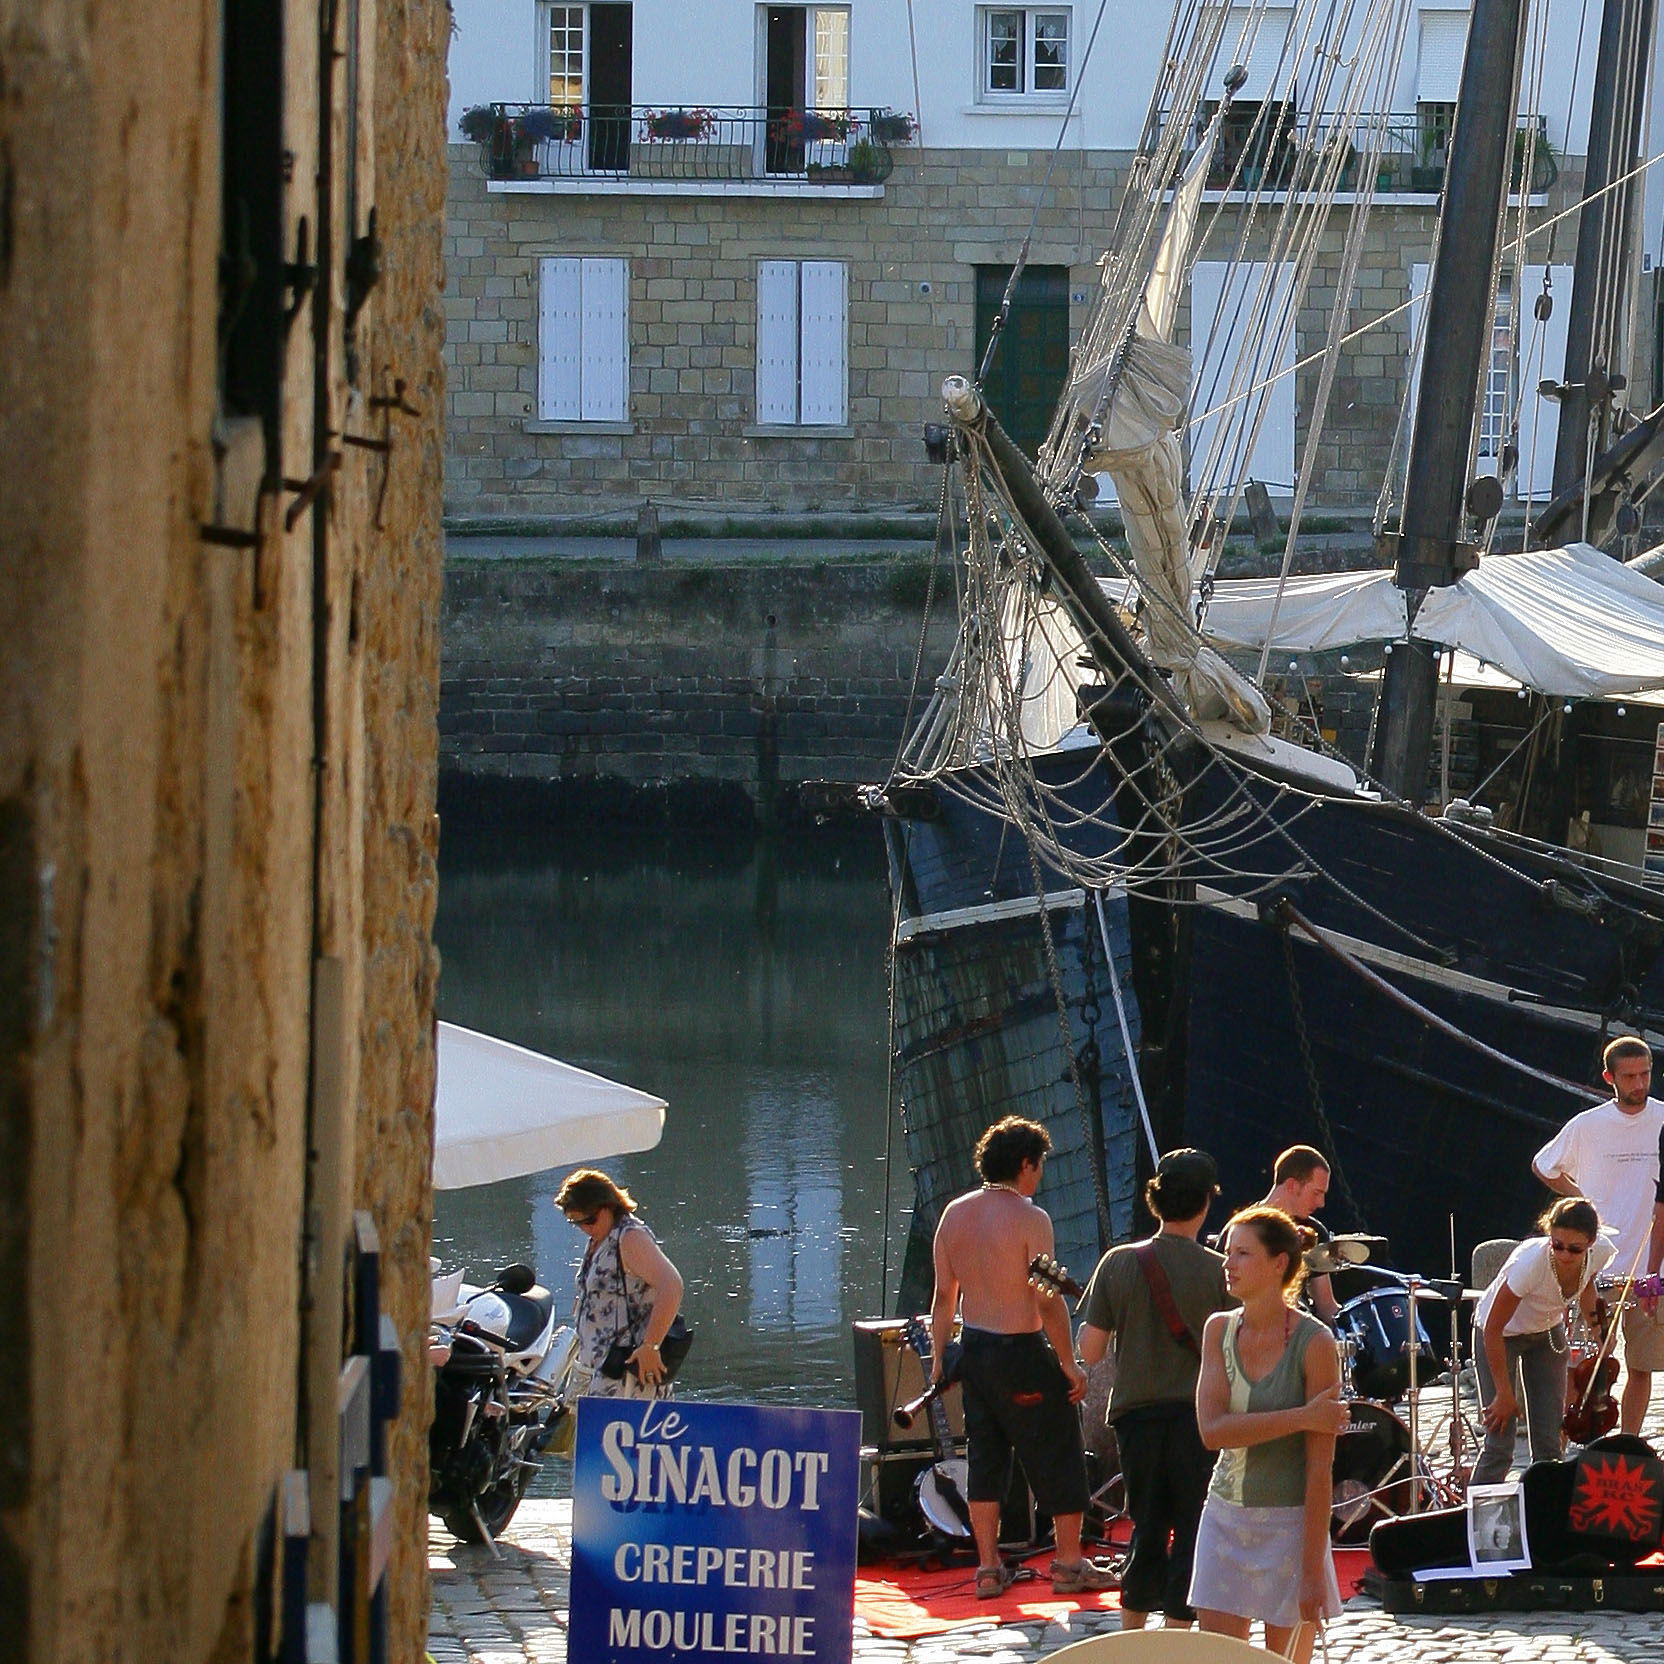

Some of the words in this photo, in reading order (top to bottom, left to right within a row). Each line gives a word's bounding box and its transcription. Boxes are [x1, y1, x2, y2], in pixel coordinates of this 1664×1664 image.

[639, 1399, 689, 1440] le
[601, 1421, 829, 1512] SINAGOT
[613, 1542, 816, 1591] CREPERIE
[609, 1607, 816, 1657] MOULERIE
